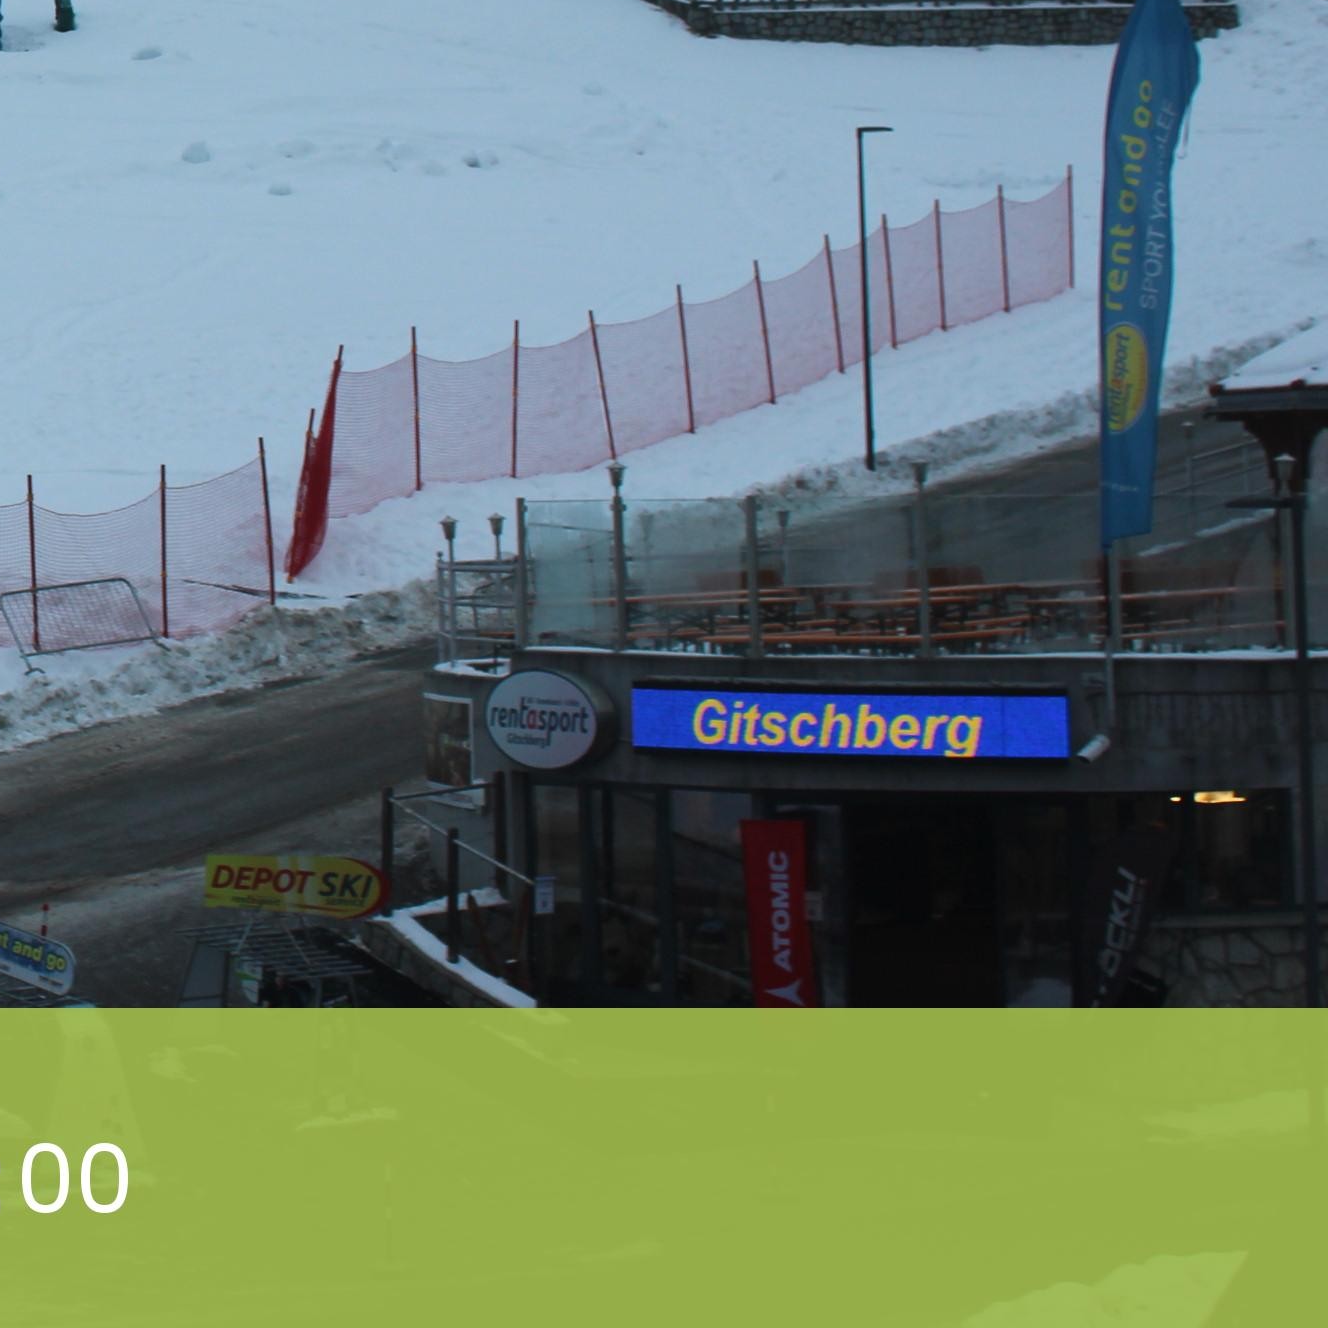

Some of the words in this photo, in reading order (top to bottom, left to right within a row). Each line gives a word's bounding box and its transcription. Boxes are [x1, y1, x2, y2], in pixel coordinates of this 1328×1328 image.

[1105, 224, 1135, 311] rent
[1140, 226, 1167, 310] SPORT
[490, 696, 588, 747] rentasport
[693, 698, 983, 758] Gitschberg
[211, 864, 314, 894] DEPOT
[318, 872, 375, 898] SKI
[767, 850, 793, 973] ATOMIC
[12, 940, 44, 962] and
[46, 952, 66, 970] go
